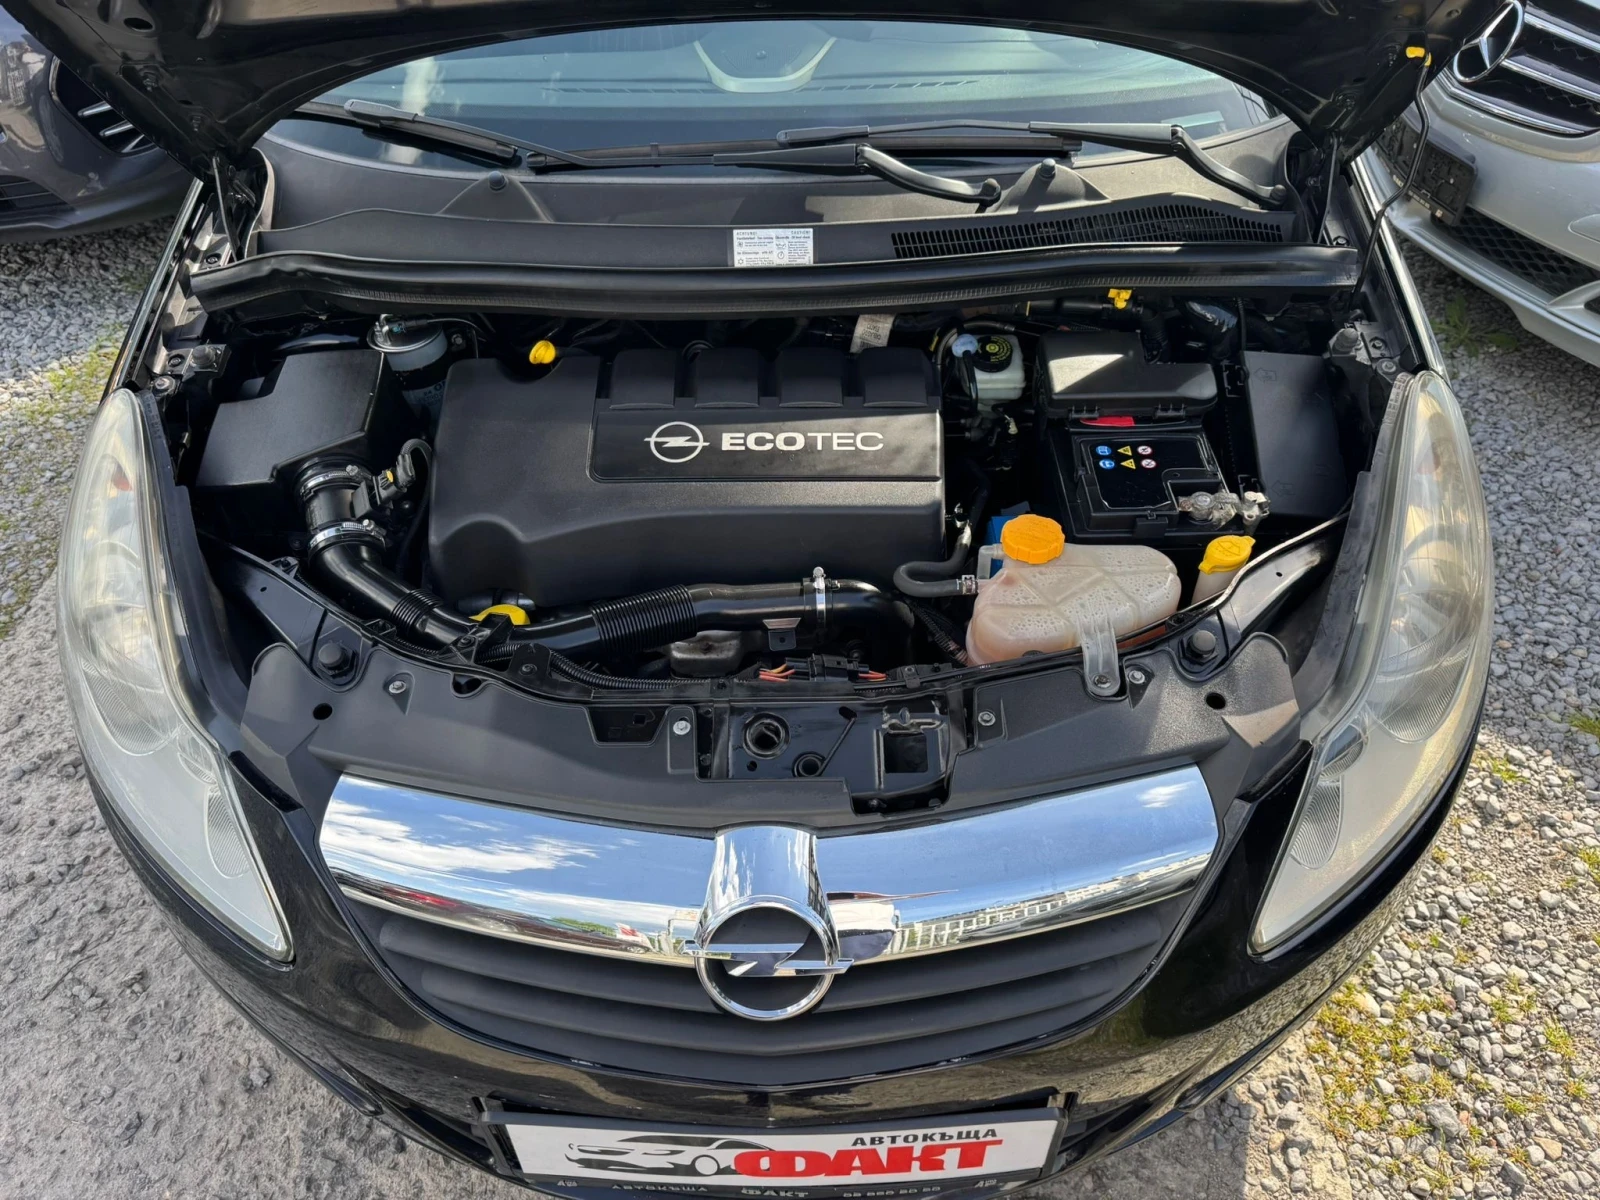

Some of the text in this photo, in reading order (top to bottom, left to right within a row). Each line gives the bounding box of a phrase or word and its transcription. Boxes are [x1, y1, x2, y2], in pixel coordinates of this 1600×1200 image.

[721, 432, 884, 451] ECOTEC
[851, 1128, 998, 1147] АВТОКЪЩА
[734, 1139, 1003, 1178] ФАКТ
[741, 1187, 809, 1198] ФАКТ
